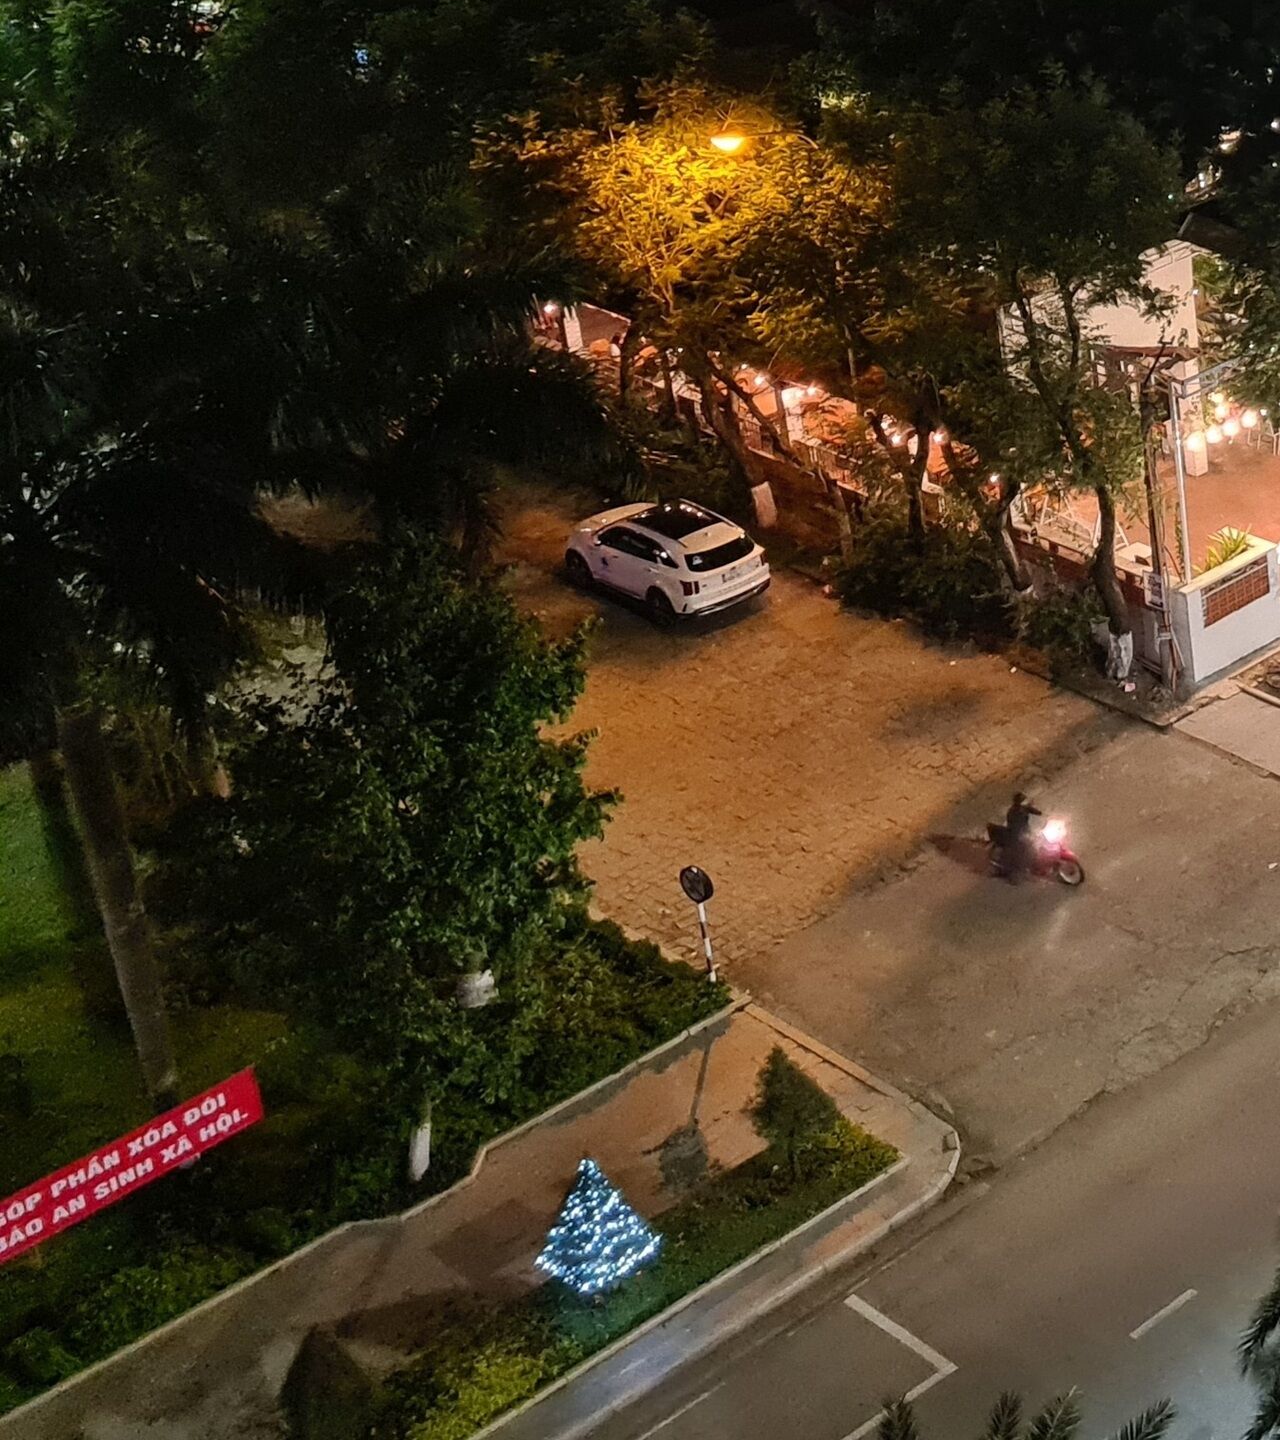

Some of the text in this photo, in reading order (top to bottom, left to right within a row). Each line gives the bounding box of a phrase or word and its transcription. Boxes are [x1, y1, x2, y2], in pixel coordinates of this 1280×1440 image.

[53, 1194, 86, 1224] AN
[94, 1158, 154, 1200] SINH
[160, 1134, 193, 1164] XÃ
